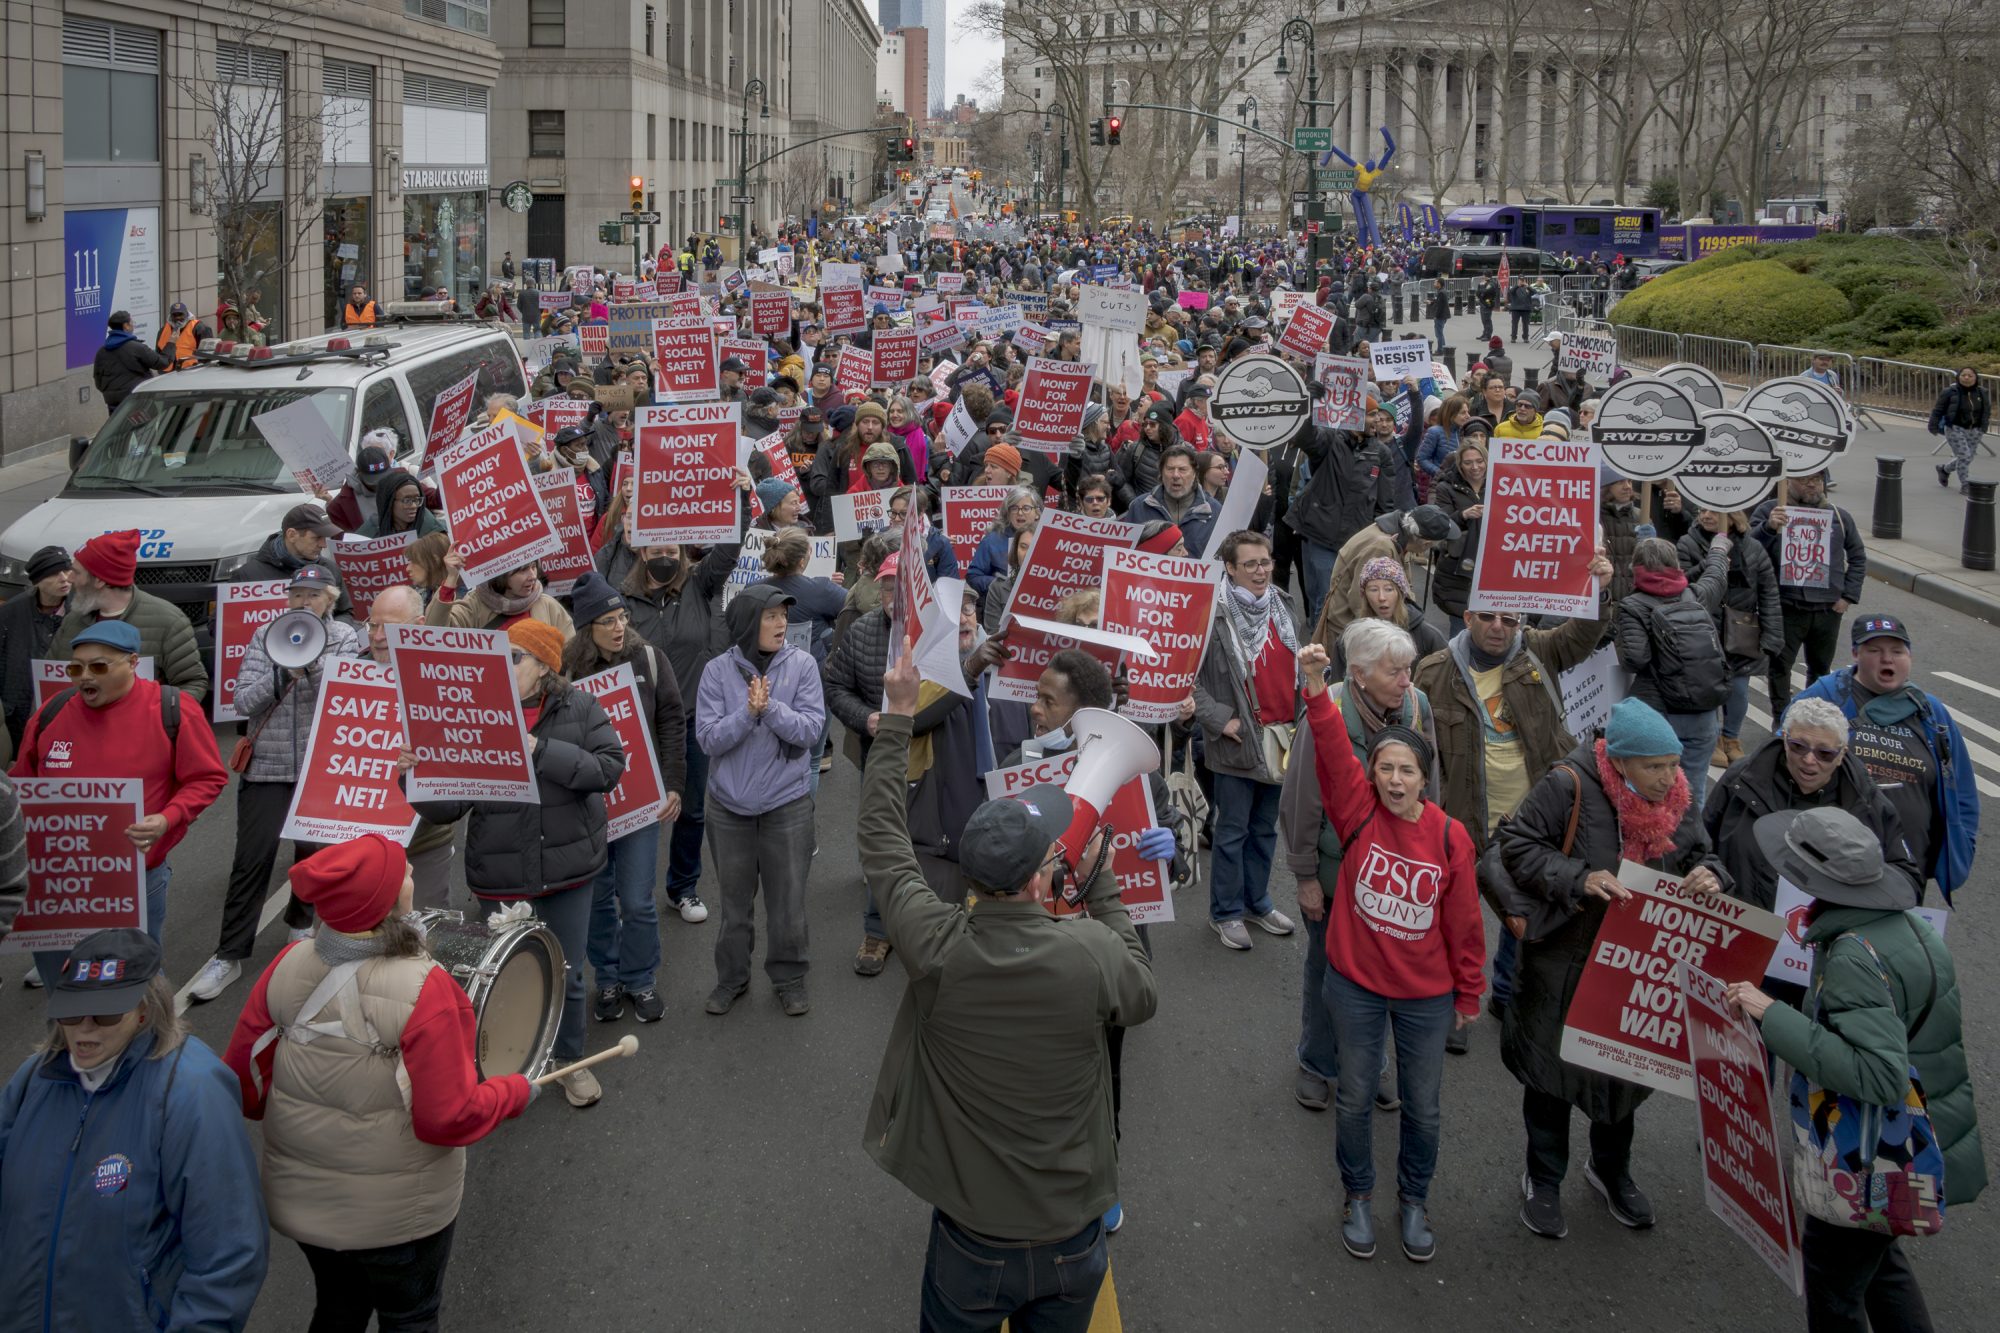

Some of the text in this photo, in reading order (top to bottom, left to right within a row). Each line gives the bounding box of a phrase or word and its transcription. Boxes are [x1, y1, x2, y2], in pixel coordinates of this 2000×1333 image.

[403, 169, 488, 188] STARBUCKS COFFEE
[74, 248, 100, 292] 111
[75, 292, 100, 307] WORTH
[1004, 292, 1046, 303] GOVERNMENT
[610, 306, 669, 320] PROTECT
[1100, 301, 1137, 311] CUTS!
[658, 318, 706, 328] PSC-CUNY
[1304, 321, 1317, 331] FOR
[582, 326, 607, 338] BUILD
[658, 333, 709, 346] SAVE THE
[878, 328, 916, 337] PSC-CUNY
[933, 327, 956, 340] STOP
[1298, 334, 1311, 342] NOT
[610, 334, 652, 348] KNOWLE
[724, 338, 763, 348] PSC-CUNY
[876, 340, 916, 350] SAVE THE
[1562, 333, 1616, 352] DEMOCRACY
[664, 348, 706, 358] SOCIAL
[1374, 350, 1425, 366] RESIST
[1568, 350, 1604, 360] NOT
[666, 360, 706, 371] SAFETY
[842, 358, 861, 369] SAVE
[880, 359, 912, 368] SAFETY
[1034, 359, 1090, 374] PSC-CUNY
[1321, 362, 1364, 376] THIS MAN
[1559, 358, 1612, 374] AUTOCRACY
[886, 369, 904, 378] NET!
[1039, 378, 1078, 390] MONEY
[1046, 390, 1067, 401] FOR
[1320, 390, 1362, 407] OUR
[1024, 399, 1082, 412] EDUCATION
[1220, 404, 1301, 417] RWDSU
[647, 406, 730, 423] PSC-CUNY
[1040, 413, 1064, 422] NOT
[1318, 410, 1360, 425] BOSS
[953, 416, 968, 440] TRUMP!
[1018, 421, 1078, 435] OLIGARCHS
[660, 434, 718, 450] MONEY
[1601, 432, 1694, 442] RWDSU
[673, 452, 704, 465] FOR
[1501, 443, 1590, 463] PSC-CUNY
[456, 454, 500, 488] MONEY
[643, 466, 733, 484] EDUCATION
[1684, 464, 1771, 474] RWDSU
[670, 486, 704, 499] NOT
[1496, 476, 1591, 500] SAVE THE
[452, 480, 528, 526] EDUCATION
[640, 500, 732, 517] OLIGARCHS
[853, 493, 882, 508] HANDS
[476, 507, 508, 532] NOT
[854, 508, 870, 520] OFF
[1504, 504, 1582, 527] SOCIAL
[1051, 514, 1134, 538] PSC-CUNY
[1808, 518, 1828, 528] MAN
[1786, 527, 1796, 538] IS
[1501, 533, 1582, 554] SAFETY
[1785, 543, 1825, 564] OUR
[340, 560, 380, 572] SAVE
[1062, 556, 1092, 572] FOR
[1116, 552, 1211, 579] PSC-CUNY
[1512, 560, 1560, 580] NET!
[1784, 562, 1824, 581] BOSS
[1126, 585, 1192, 609] MONEY
[1479, 594, 1517, 602] Professional
[1137, 608, 1174, 628] FOR
[1866, 620, 1892, 632] PSC
[400, 628, 496, 650] PSC-CUNY
[420, 662, 484, 683] MONEY
[1576, 674, 1596, 694] NEED
[437, 686, 476, 704] FOR
[1565, 684, 1604, 716] EADERSHIP
[328, 696, 390, 721] SAVE
[409, 704, 514, 726] EDUCATION
[444, 728, 483, 744] NOT
[1856, 732, 1904, 750] FOR OUR
[52, 740, 72, 752] PSC
[415, 746, 524, 767] OLIGARCHS
[1855, 746, 1927, 772] DEMOCRACY,
[416, 782, 458, 790] Professional
[476, 782, 529, 792] Congress/CUNY
[334, 784, 388, 810] NET!
[25, 815, 108, 832] MONEY
[44, 836, 91, 852] FOR
[46, 877, 93, 894] NOT
[1361, 850, 1438, 908] PSC
[1362, 892, 1426, 924] CUNY
[1640, 900, 1741, 950] MONEY
[1650, 930, 1707, 968] FOR
[77, 960, 117, 981] PSC
[1784, 956, 1808, 971] on
[1628, 980, 1686, 1018] NOT
[1620, 1006, 1682, 1049] WAR
[1598, 1050, 1610, 1058] AFT
[1628, 1052, 1648, 1062] STAFF
[1705, 1023, 1750, 1076] MONEY
[1720, 1062, 1745, 1103] FOR
[1701, 1075, 1773, 1157] EDUCATION
[1726, 1124, 1754, 1164] NOT
[98, 1162, 123, 1176] CUNY
[1706, 1138, 1784, 1226] OLIGARCHS
